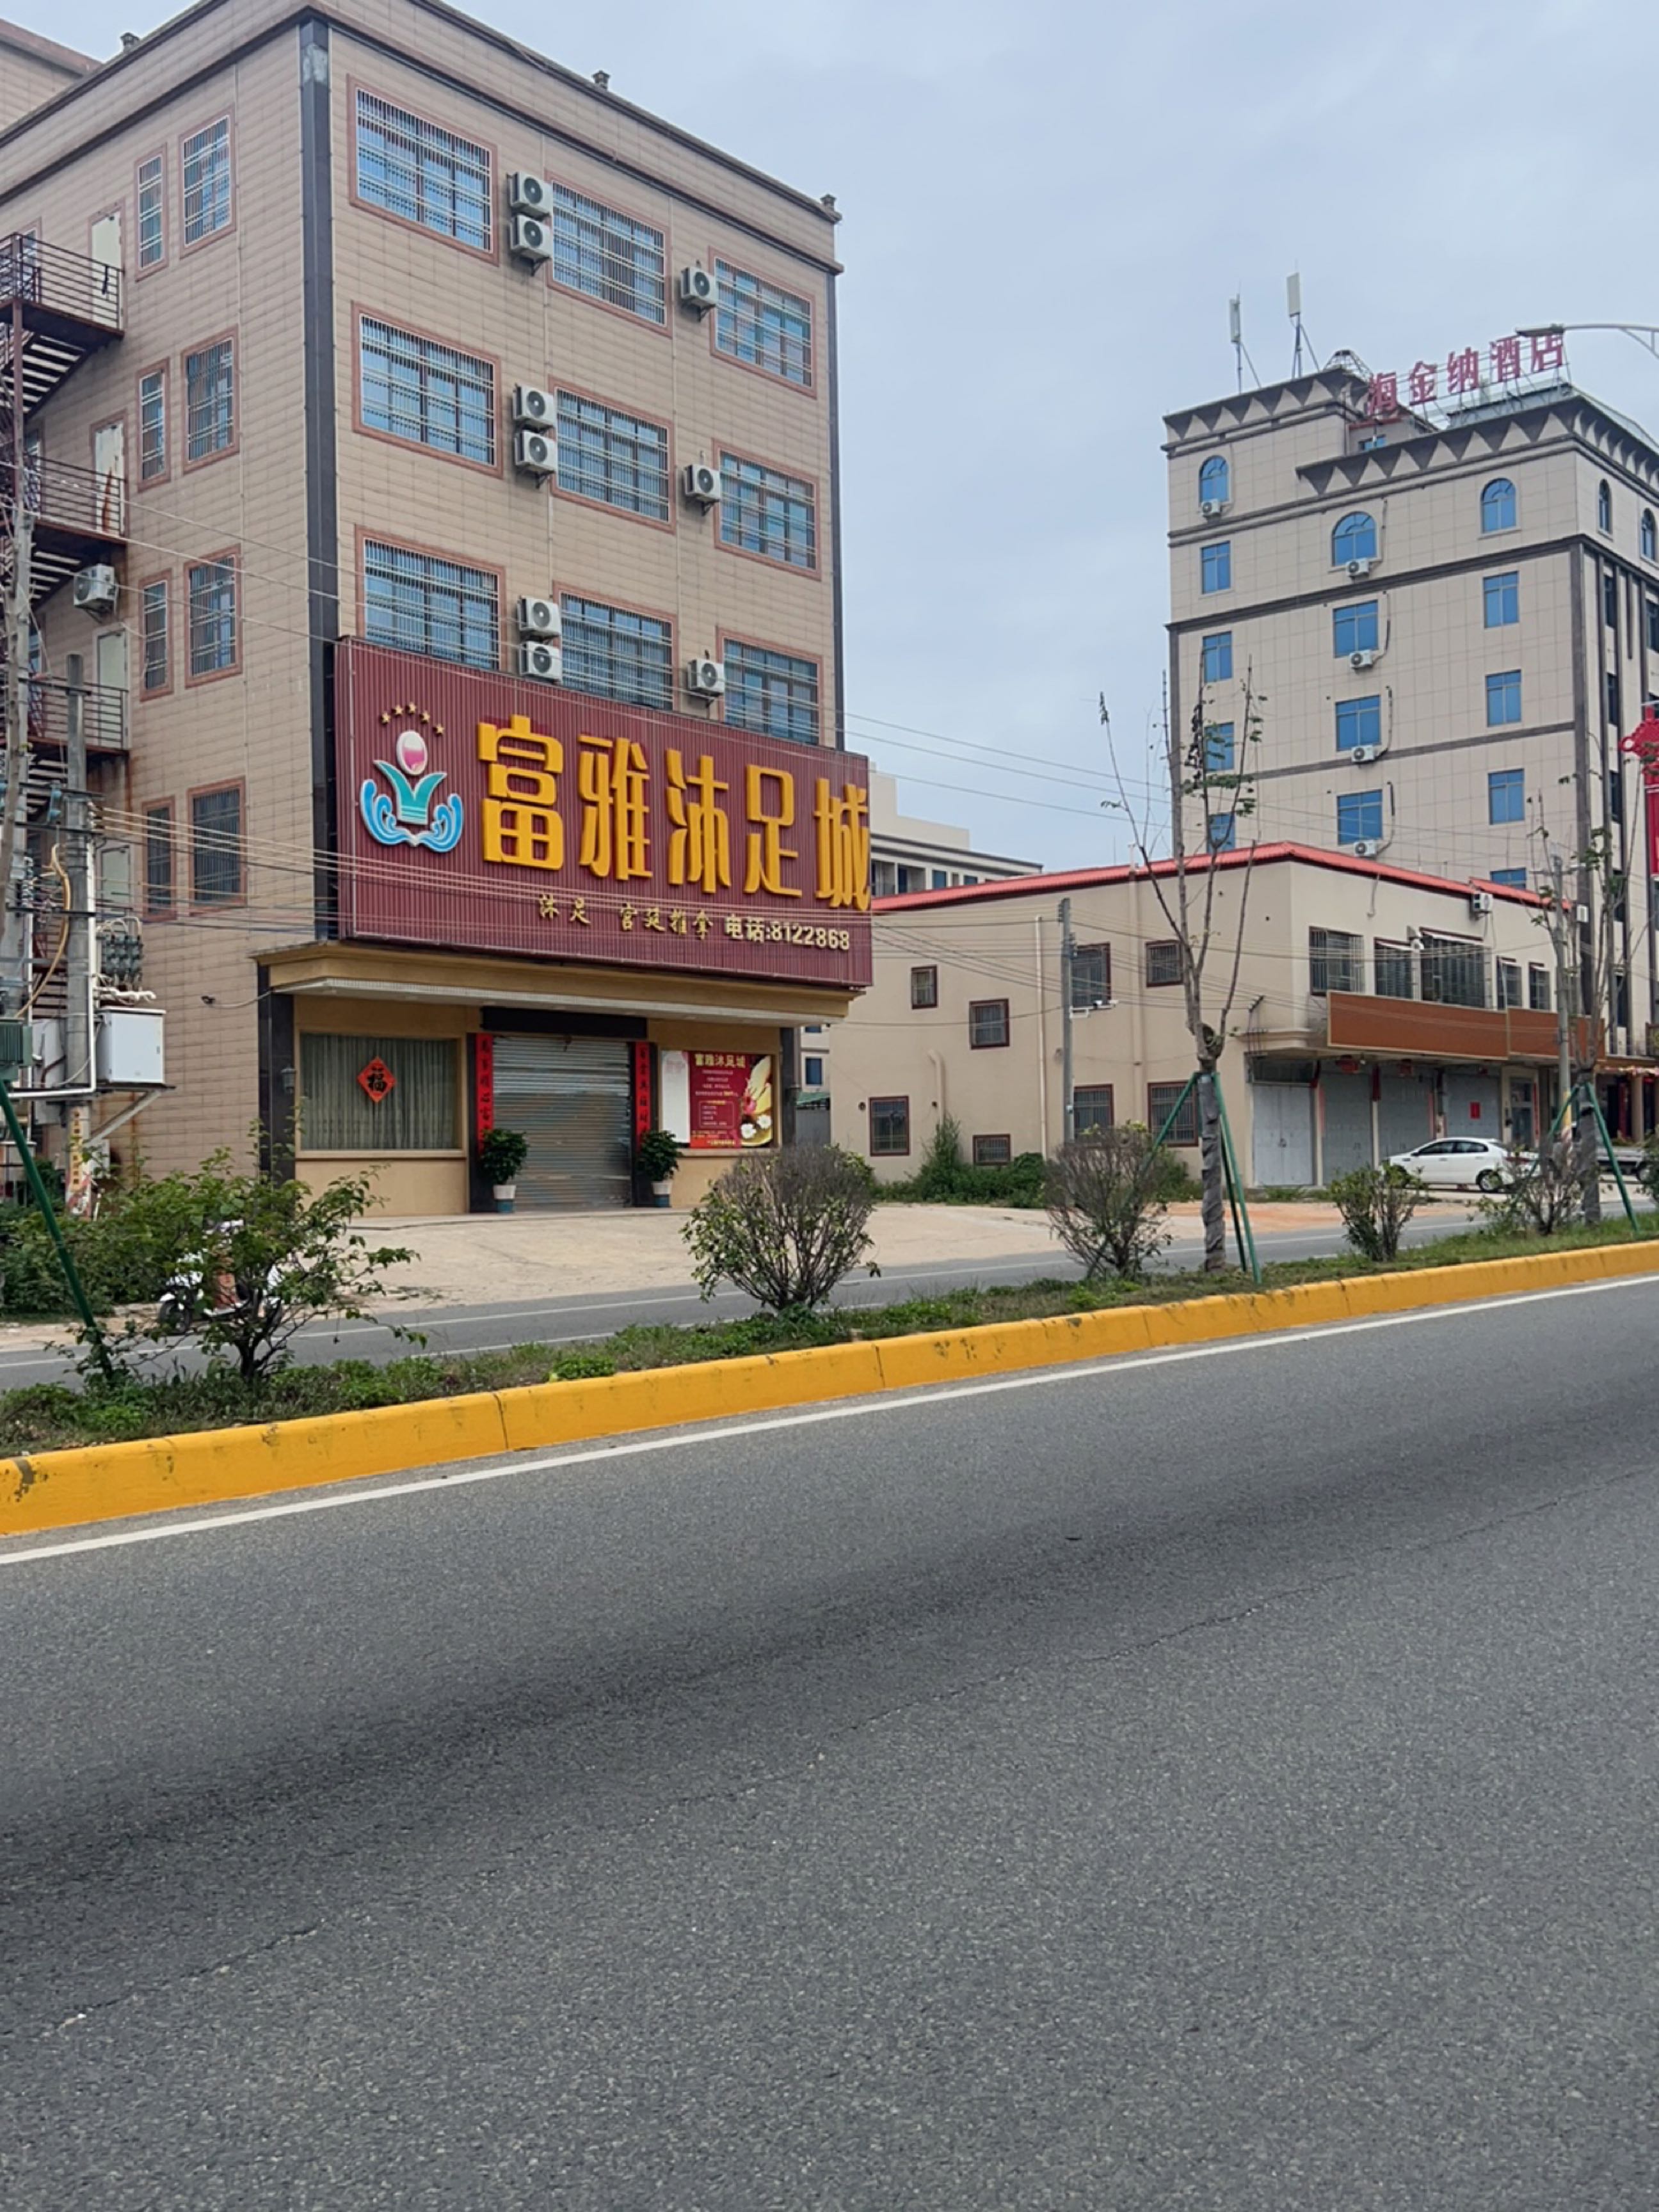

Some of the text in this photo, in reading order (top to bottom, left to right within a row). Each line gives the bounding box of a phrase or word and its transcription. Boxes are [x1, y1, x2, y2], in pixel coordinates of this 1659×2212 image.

[477, 714, 870, 911] 富雅沐足城
[538, 894, 591, 926] 沐足
[367, 1067, 389, 1093] 福
